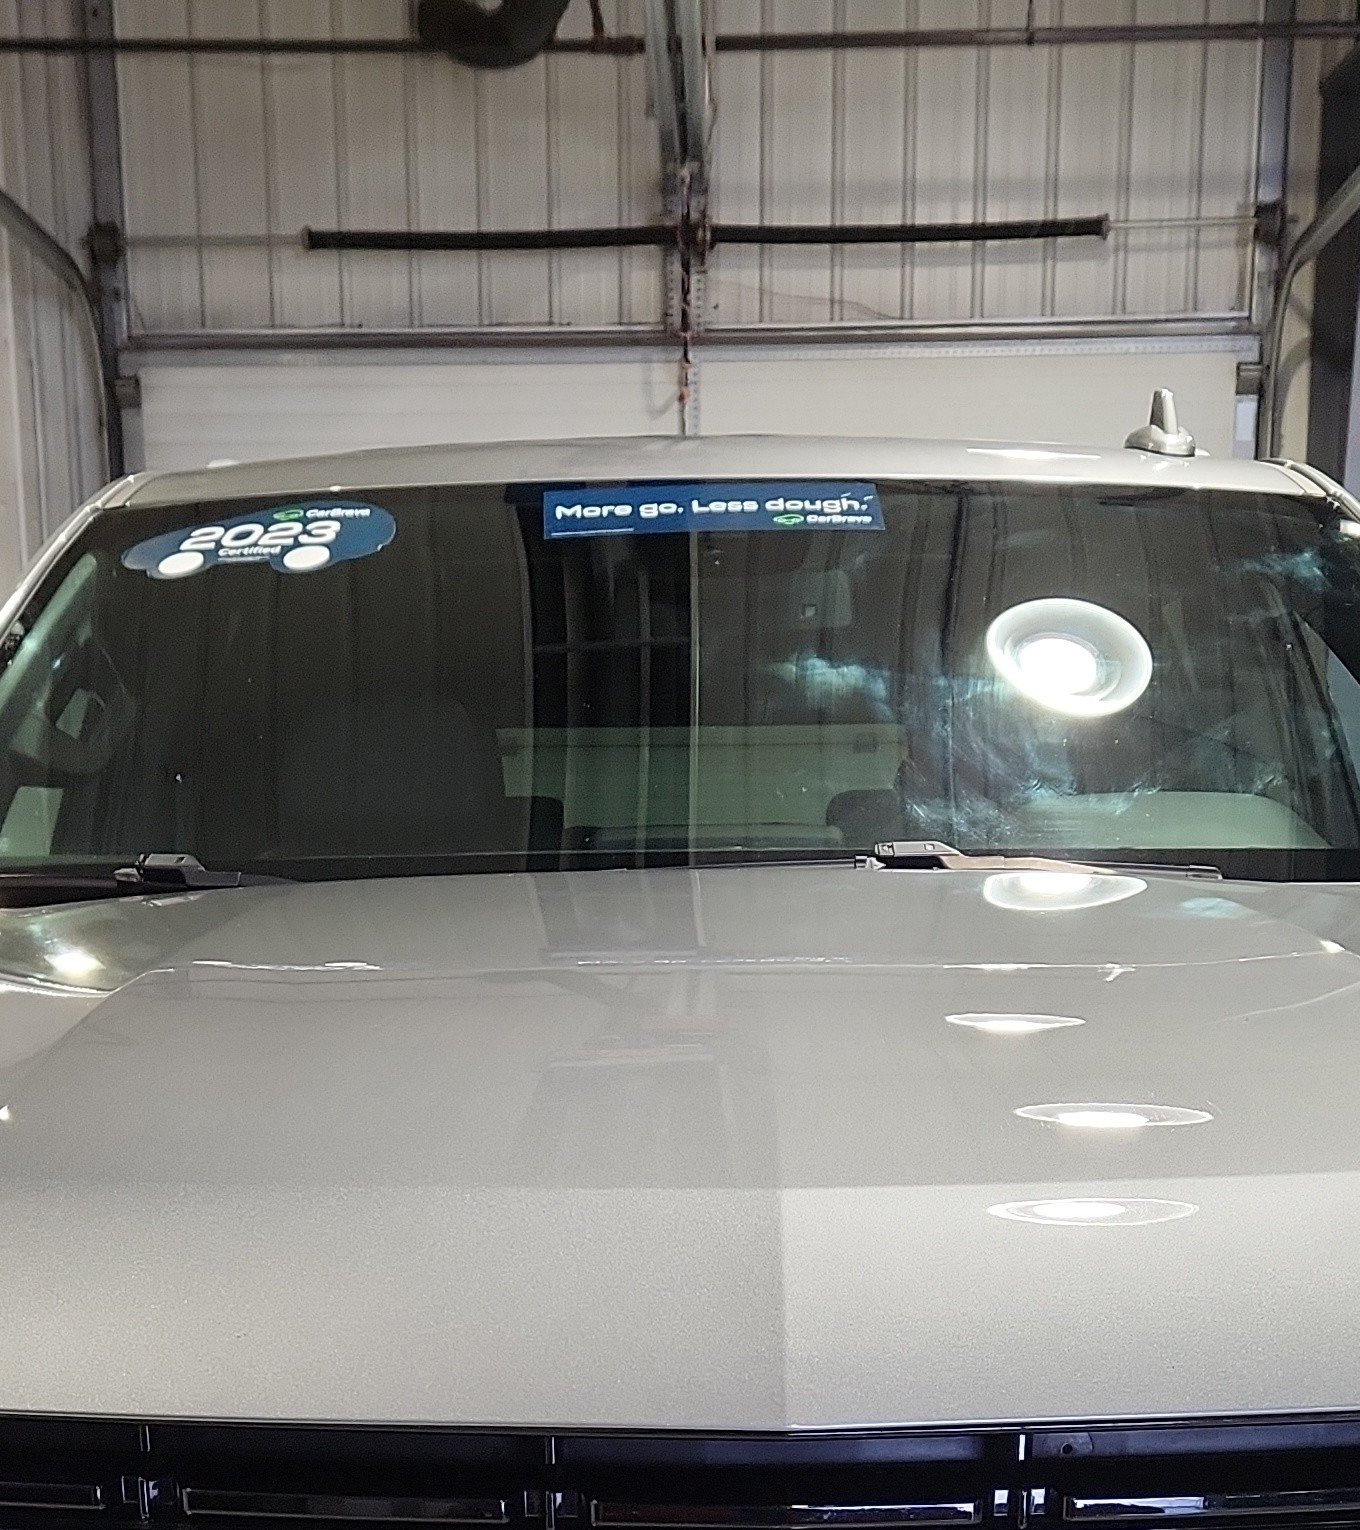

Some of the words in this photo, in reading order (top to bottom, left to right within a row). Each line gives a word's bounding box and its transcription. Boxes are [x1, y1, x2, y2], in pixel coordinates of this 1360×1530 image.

[554, 503, 634, 521] More
[638, 501, 684, 519] go.
[691, 499, 759, 514] Less
[765, 496, 868, 514] dough.
[179, 519, 342, 551] 2023
[217, 545, 281, 558] Certified
